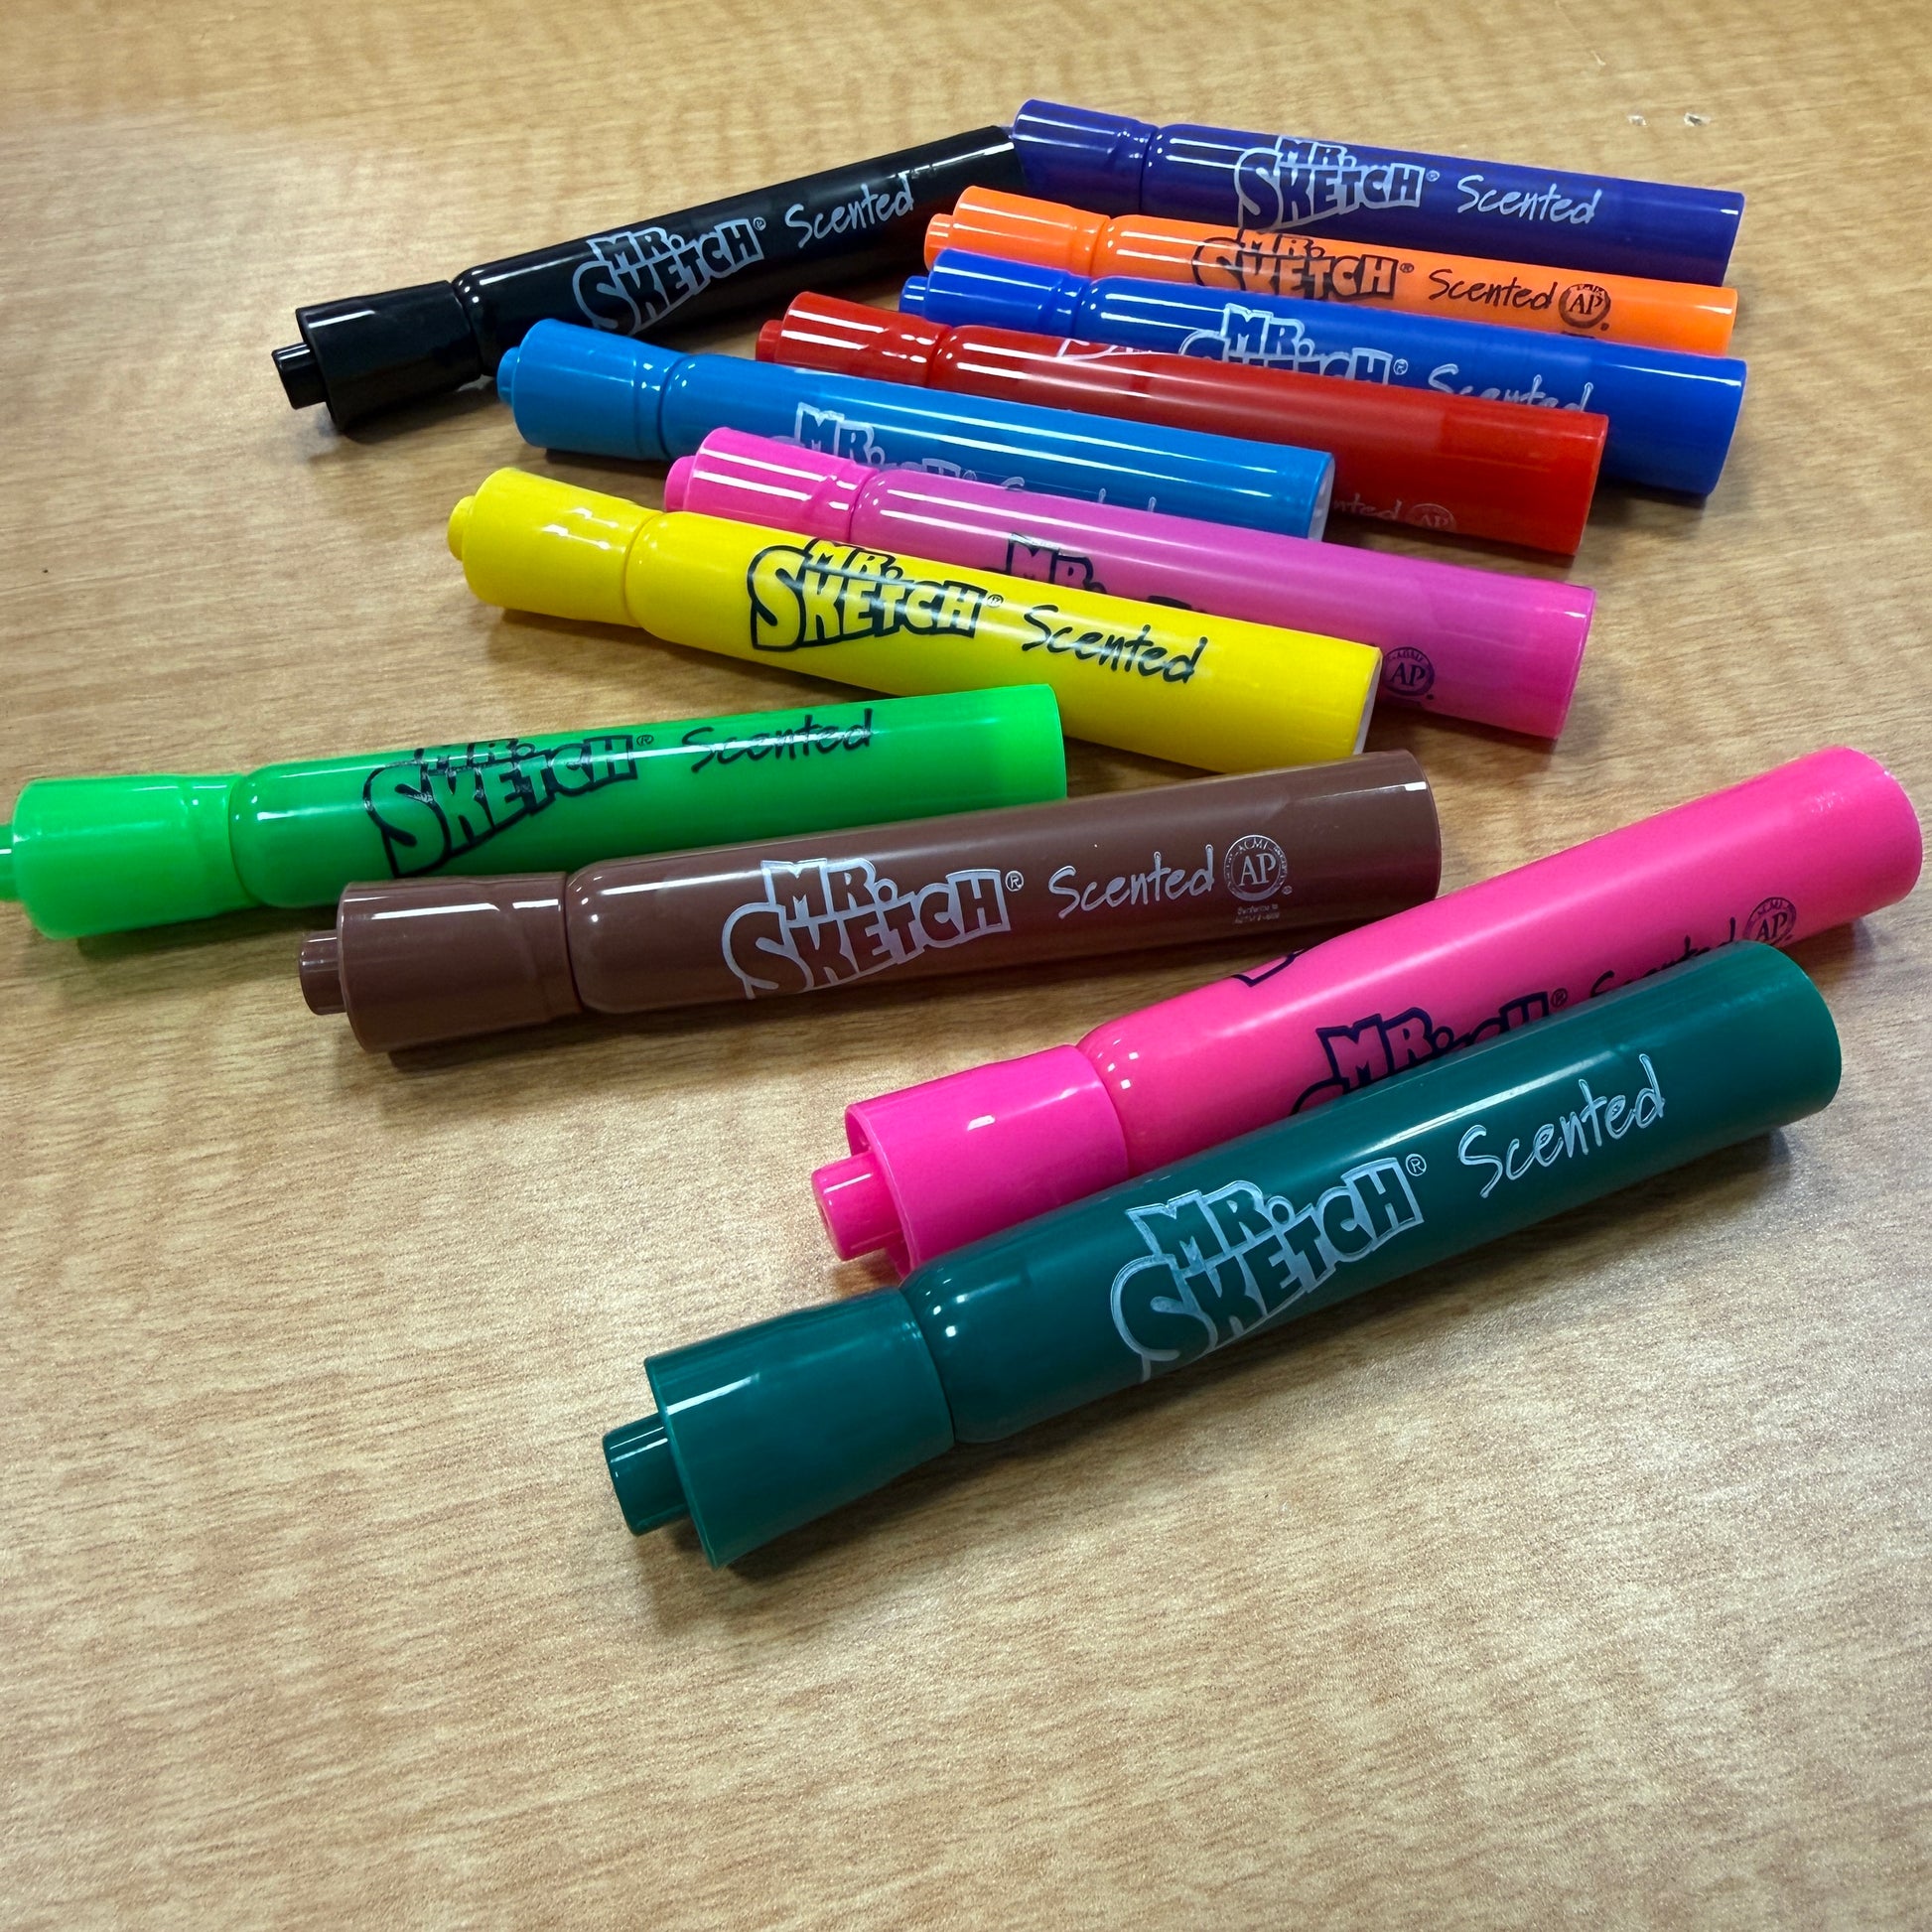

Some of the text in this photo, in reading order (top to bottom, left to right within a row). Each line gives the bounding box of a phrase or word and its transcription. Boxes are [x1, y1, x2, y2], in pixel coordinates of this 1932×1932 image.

[1276, 135, 1357, 168] MR.
[1234, 148, 1602, 232] SKETCH Scented
[573, 173, 914, 336] SKETCH Scented
[587, 226, 685, 272] MR.
[1237, 229, 1325, 259] MR.
[1429, 269, 1558, 310] Scented
[1219, 303, 1315, 357] MR.
[794, 402, 886, 468] MR.
[804, 537, 903, 582] MR.
[748, 545, 1209, 685] SKETCH Scented
[1391, 662, 1427, 686] AP
[362, 708, 873, 879] SKETCH Scented
[722, 869, 1012, 999] SKETCH
[1048, 844, 1215, 919] Scented
[1238, 853, 1277, 887] AP
[760, 858, 899, 923] MR.
[1315, 1007, 1454, 1091] MR.
[1110, 1053, 1665, 1382] SKETCH Scented
[1126, 1180, 1297, 1269] MR.
